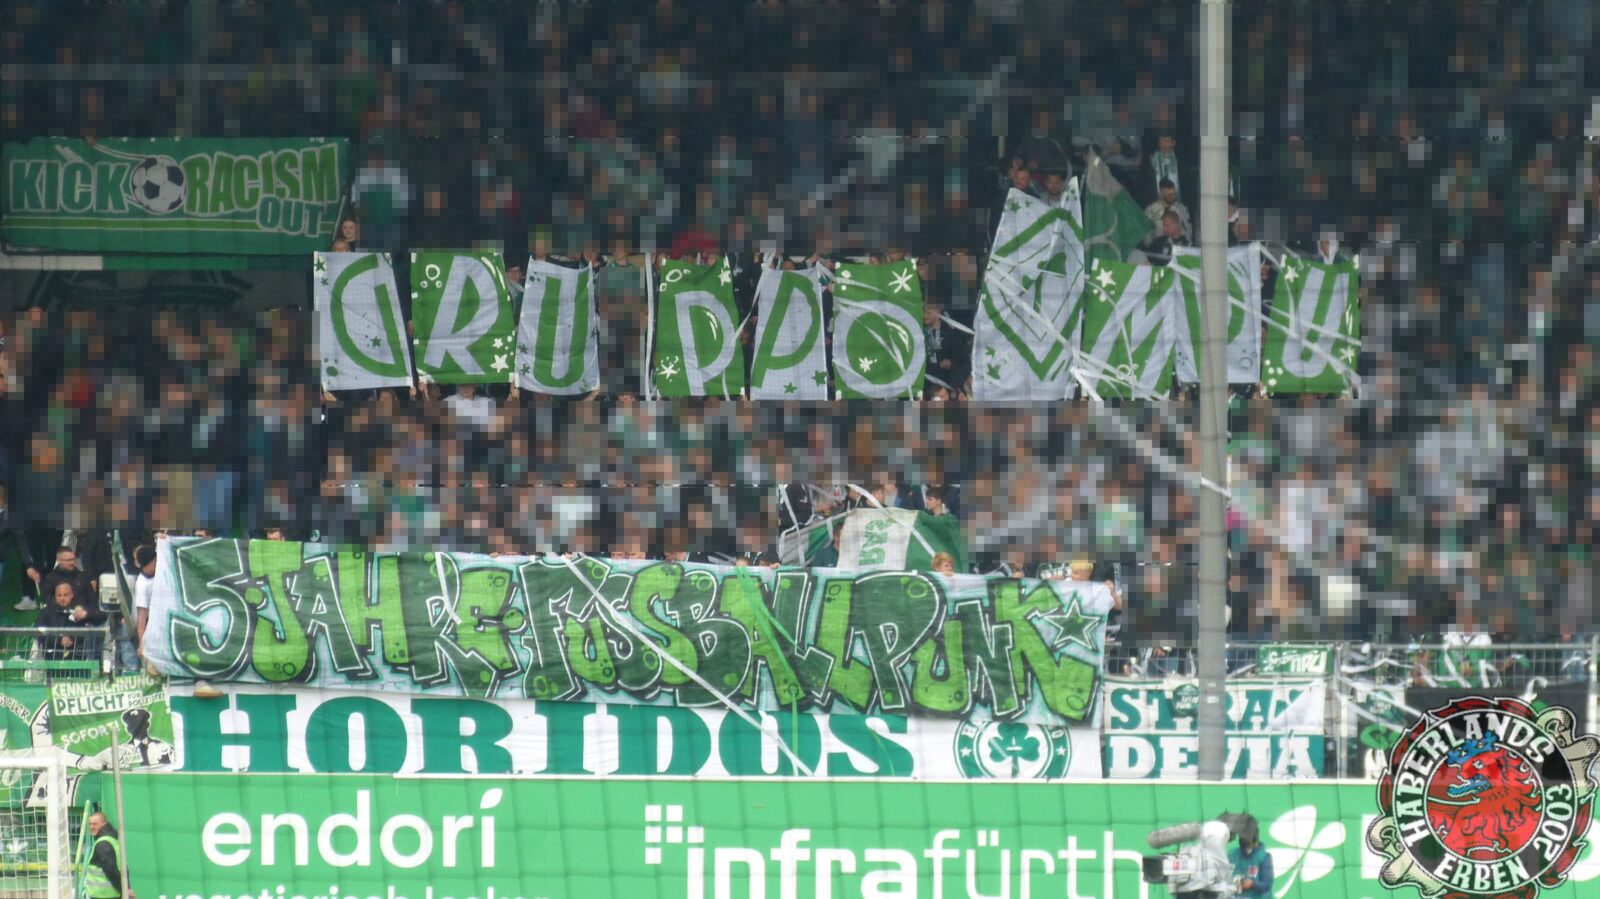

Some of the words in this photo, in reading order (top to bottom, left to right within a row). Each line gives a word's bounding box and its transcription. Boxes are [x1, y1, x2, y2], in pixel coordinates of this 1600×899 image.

[9, 159, 130, 213] KICK
[182, 143, 340, 217] RACISM
[256, 195, 327, 238] OUT
[171, 538, 250, 676] 5
[52, 675, 155, 697] KENNZEICHNUNG
[55, 693, 125, 714] PFLICHT
[169, 694, 915, 776] HORIDOS
[201, 788, 503, 868] endori
